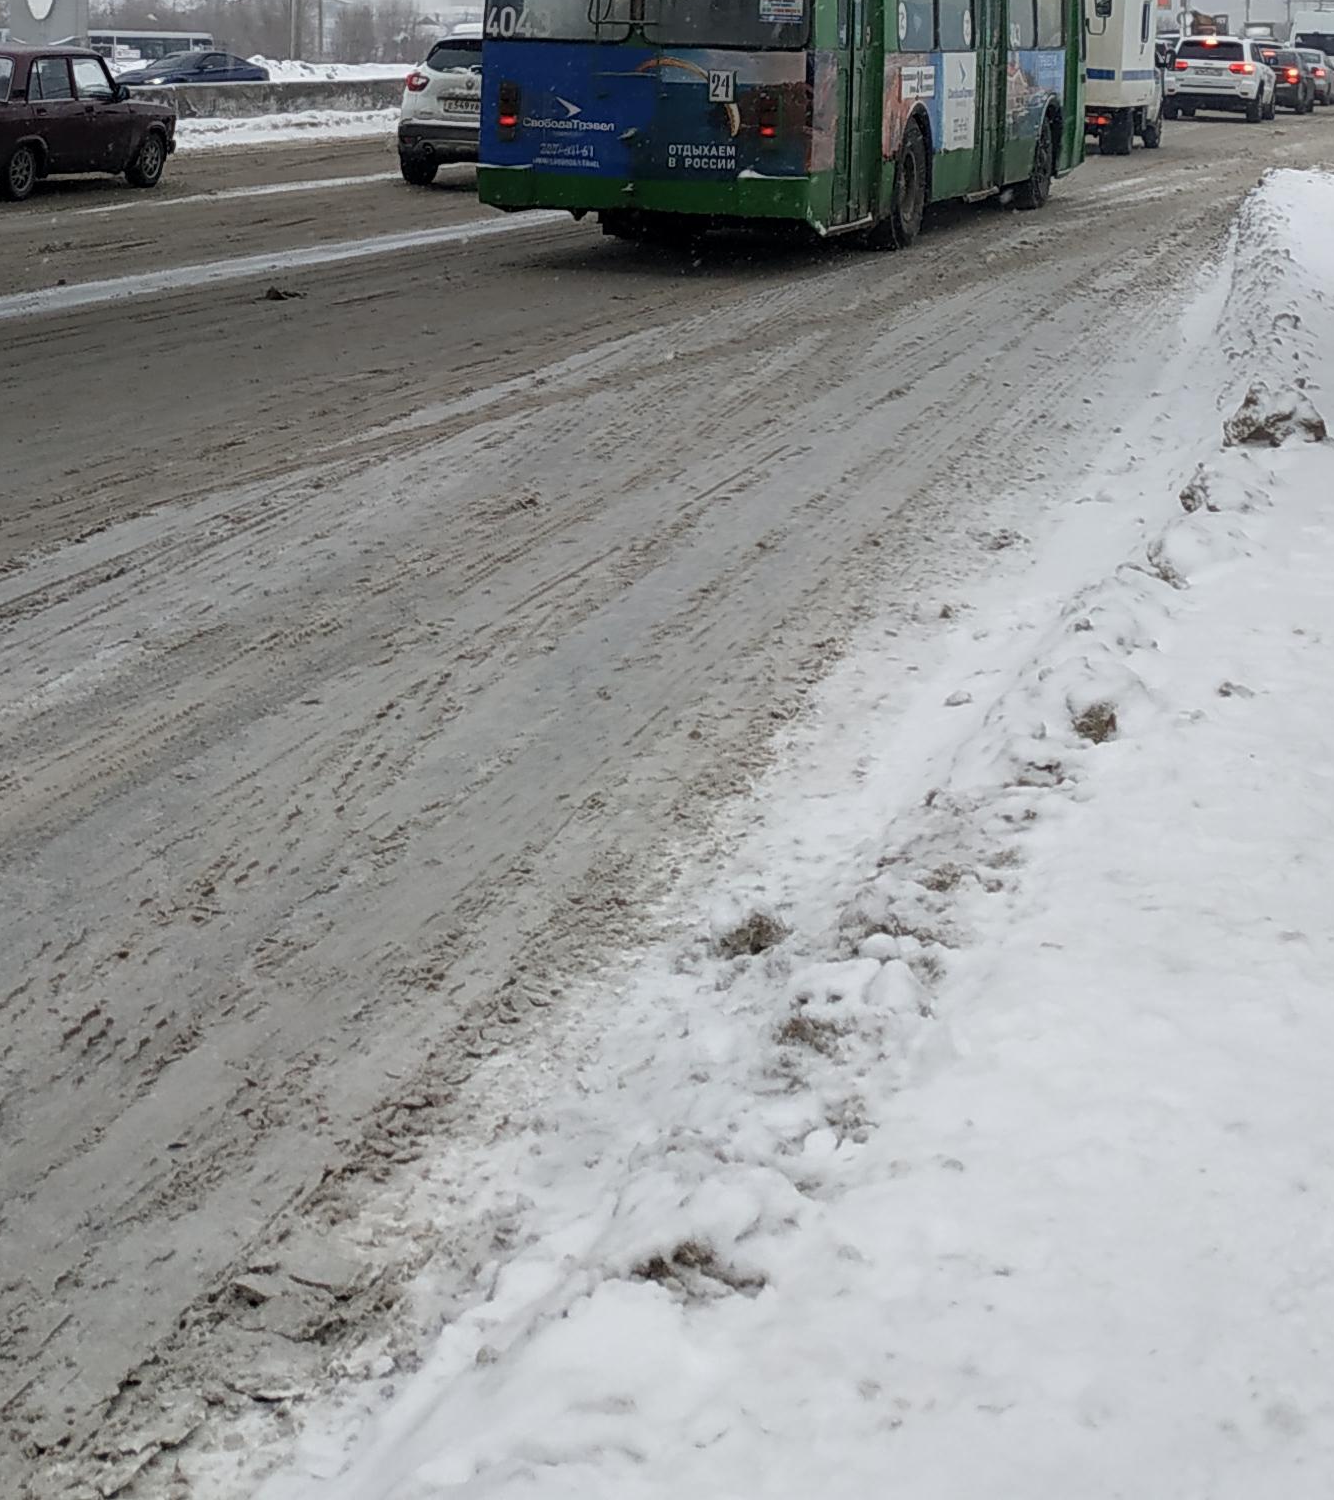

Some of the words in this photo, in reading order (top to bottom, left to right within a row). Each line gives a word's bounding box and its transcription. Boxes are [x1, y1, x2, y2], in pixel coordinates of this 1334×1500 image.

[710, 73, 731, 99] 24
[522, 117, 616, 132] СвободаТрэвел
[668, 144, 736, 157] ОТДЫХАЕМ
[668, 157, 676, 168] В
[684, 158, 736, 170] РОССИИ
